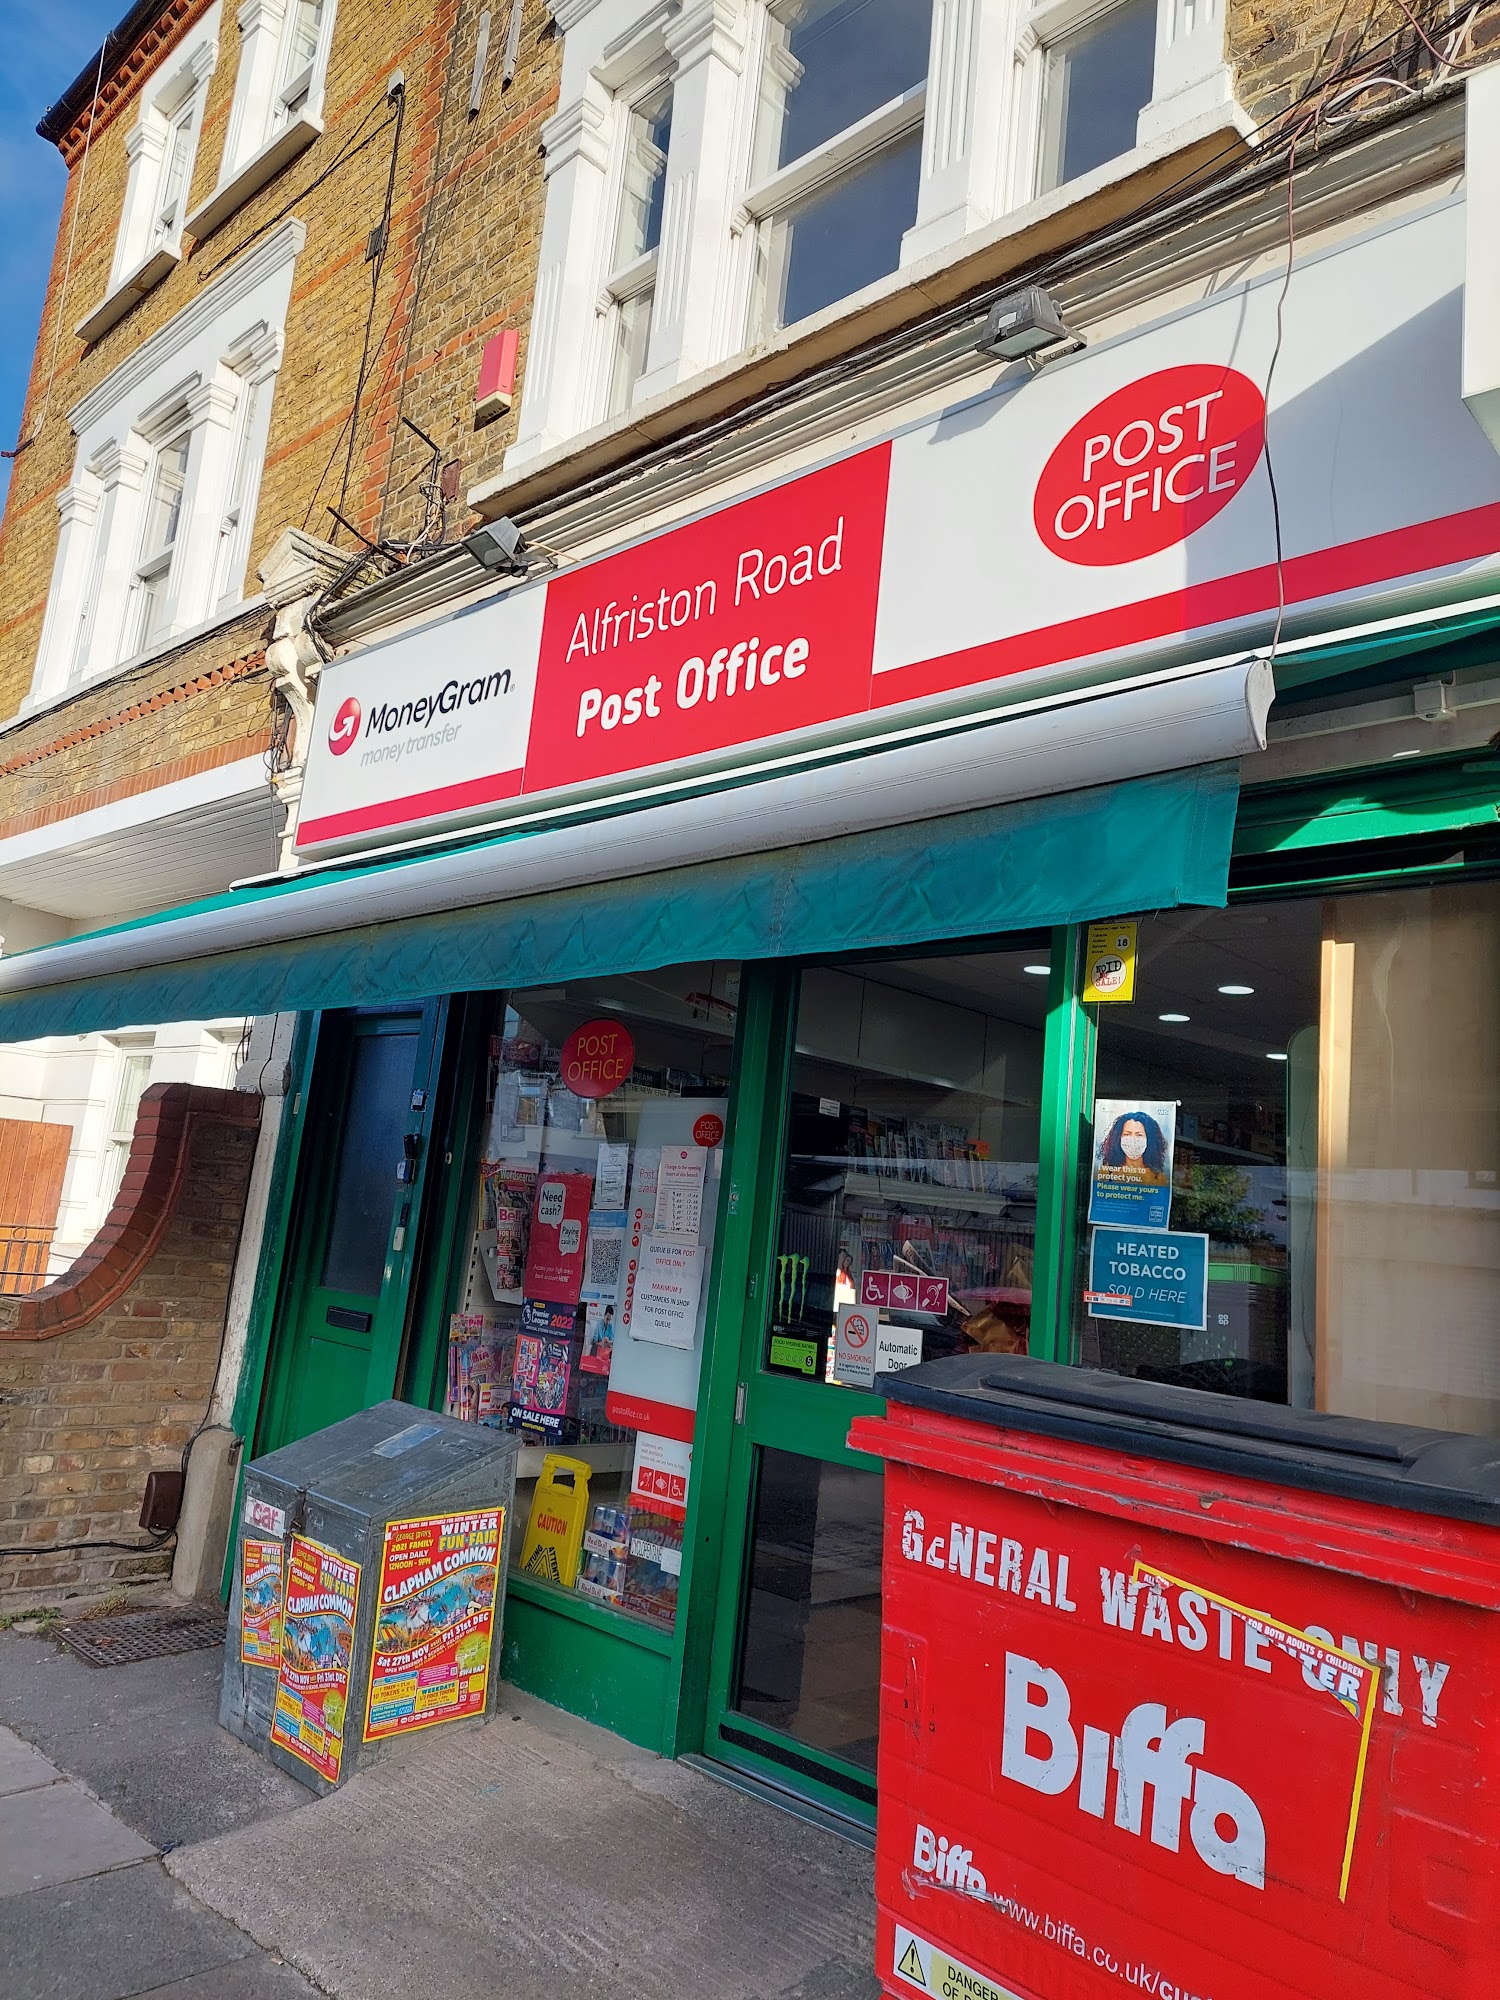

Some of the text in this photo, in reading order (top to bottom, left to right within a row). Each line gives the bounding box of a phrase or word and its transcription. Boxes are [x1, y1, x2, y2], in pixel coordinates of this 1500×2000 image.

[1083, 390, 1223, 483] POST
[1054, 441, 1237, 540] OFFICE
[564, 515, 845, 664] Alfriston Road
[576, 636, 810, 738] Post Office
[360, 723, 462, 767] money transfer
[1117, 938, 1128, 947] 18
[1095, 976, 1121, 987] SALE!
[577, 1033, 618, 1057] POST
[567, 1059, 624, 1082] OFFICE
[700, 1121, 719, 1130] POST
[695, 1131, 720, 1140] OFFICE
[1122, 1165, 1137, 1173] this
[1097, 1173, 1143, 1184] protect you.
[542, 1191, 564, 1203] Need
[1096, 1190, 1104, 1198] to
[1105, 1191, 1132, 1201] protect
[1097, 1183, 1119, 1191] Please
[1139, 1187, 1159, 1196] yours
[540, 1204, 562, 1216] cash?
[562, 1226, 579, 1238] Paying
[649, 1245, 666, 1254] QUEUE
[671, 1247, 682, 1255] FOR
[682, 1249, 696, 1257] POST
[1116, 1242, 1180, 1260] HEATED
[655, 1258, 686, 1268] OFFICE ONLY
[1108, 1261, 1187, 1281] TOBACCO
[651, 1283, 678, 1293] MAXIMUM
[1106, 1284, 1145, 1299] SOLD
[1149, 1288, 1188, 1304] HERE
[640, 1293, 670, 1304] CUSTOMERS
[676, 1299, 690, 1307] SHOP
[532, 1308, 550, 1318] Premier
[644, 1305, 684, 1319] FOR POST OFFICE
[531, 1314, 574, 1330] League 2022
[654, 1320, 672, 1329] QUEUE
[879, 1340, 918, 1356] Automatic
[838, 1352, 873, 1364] NO SMOKING.
[888, 1358, 908, 1371] Door
[511, 1406, 561, 1428] ON SALE HERE
[612, 1406, 651, 1421] postoffice.co.uk
[440, 1517, 498, 1536] WINTER
[537, 1512, 568, 1536] CAUTION
[391, 1539, 434, 1552] 2021 FAMILY
[439, 1529, 498, 1552] FUN-FAIR
[588, 1535, 598, 1546] Red
[389, 1549, 429, 1562] OPEN DAILY
[524, 1544, 543, 1572] CHTUNG
[321, 1558, 356, 1586] WINTER
[389, 1560, 413, 1571] 12NOON
[418, 1558, 431, 1566] 9PM
[384, 1546, 496, 1602] CLAPHAM COMMON
[320, 1571, 355, 1600] FUN-FAIR
[287, 1593, 354, 1620] CLAPHAM COMMON
[376, 1656, 391, 1667] Sat
[391, 1653, 410, 1666] 27th
[412, 1643, 429, 1659] NOV
[442, 1631, 454, 1643] Fri
[454, 1621, 471, 1636] 31st
[472, 1612, 489, 1625] DEC
[1264, 1625, 1285, 1642] BOTH
[1286, 1635, 1315, 1656] ADULTS
[1316, 1649, 1324, 1660] &
[1325, 1654, 1364, 1679] CHILDREN
[421, 1682, 456, 1695] WEEKDAYS
[1001, 1651, 1265, 1891] Biffa
[913, 1824, 987, 1904] Biffa
[942, 1982, 959, 2000] OF
